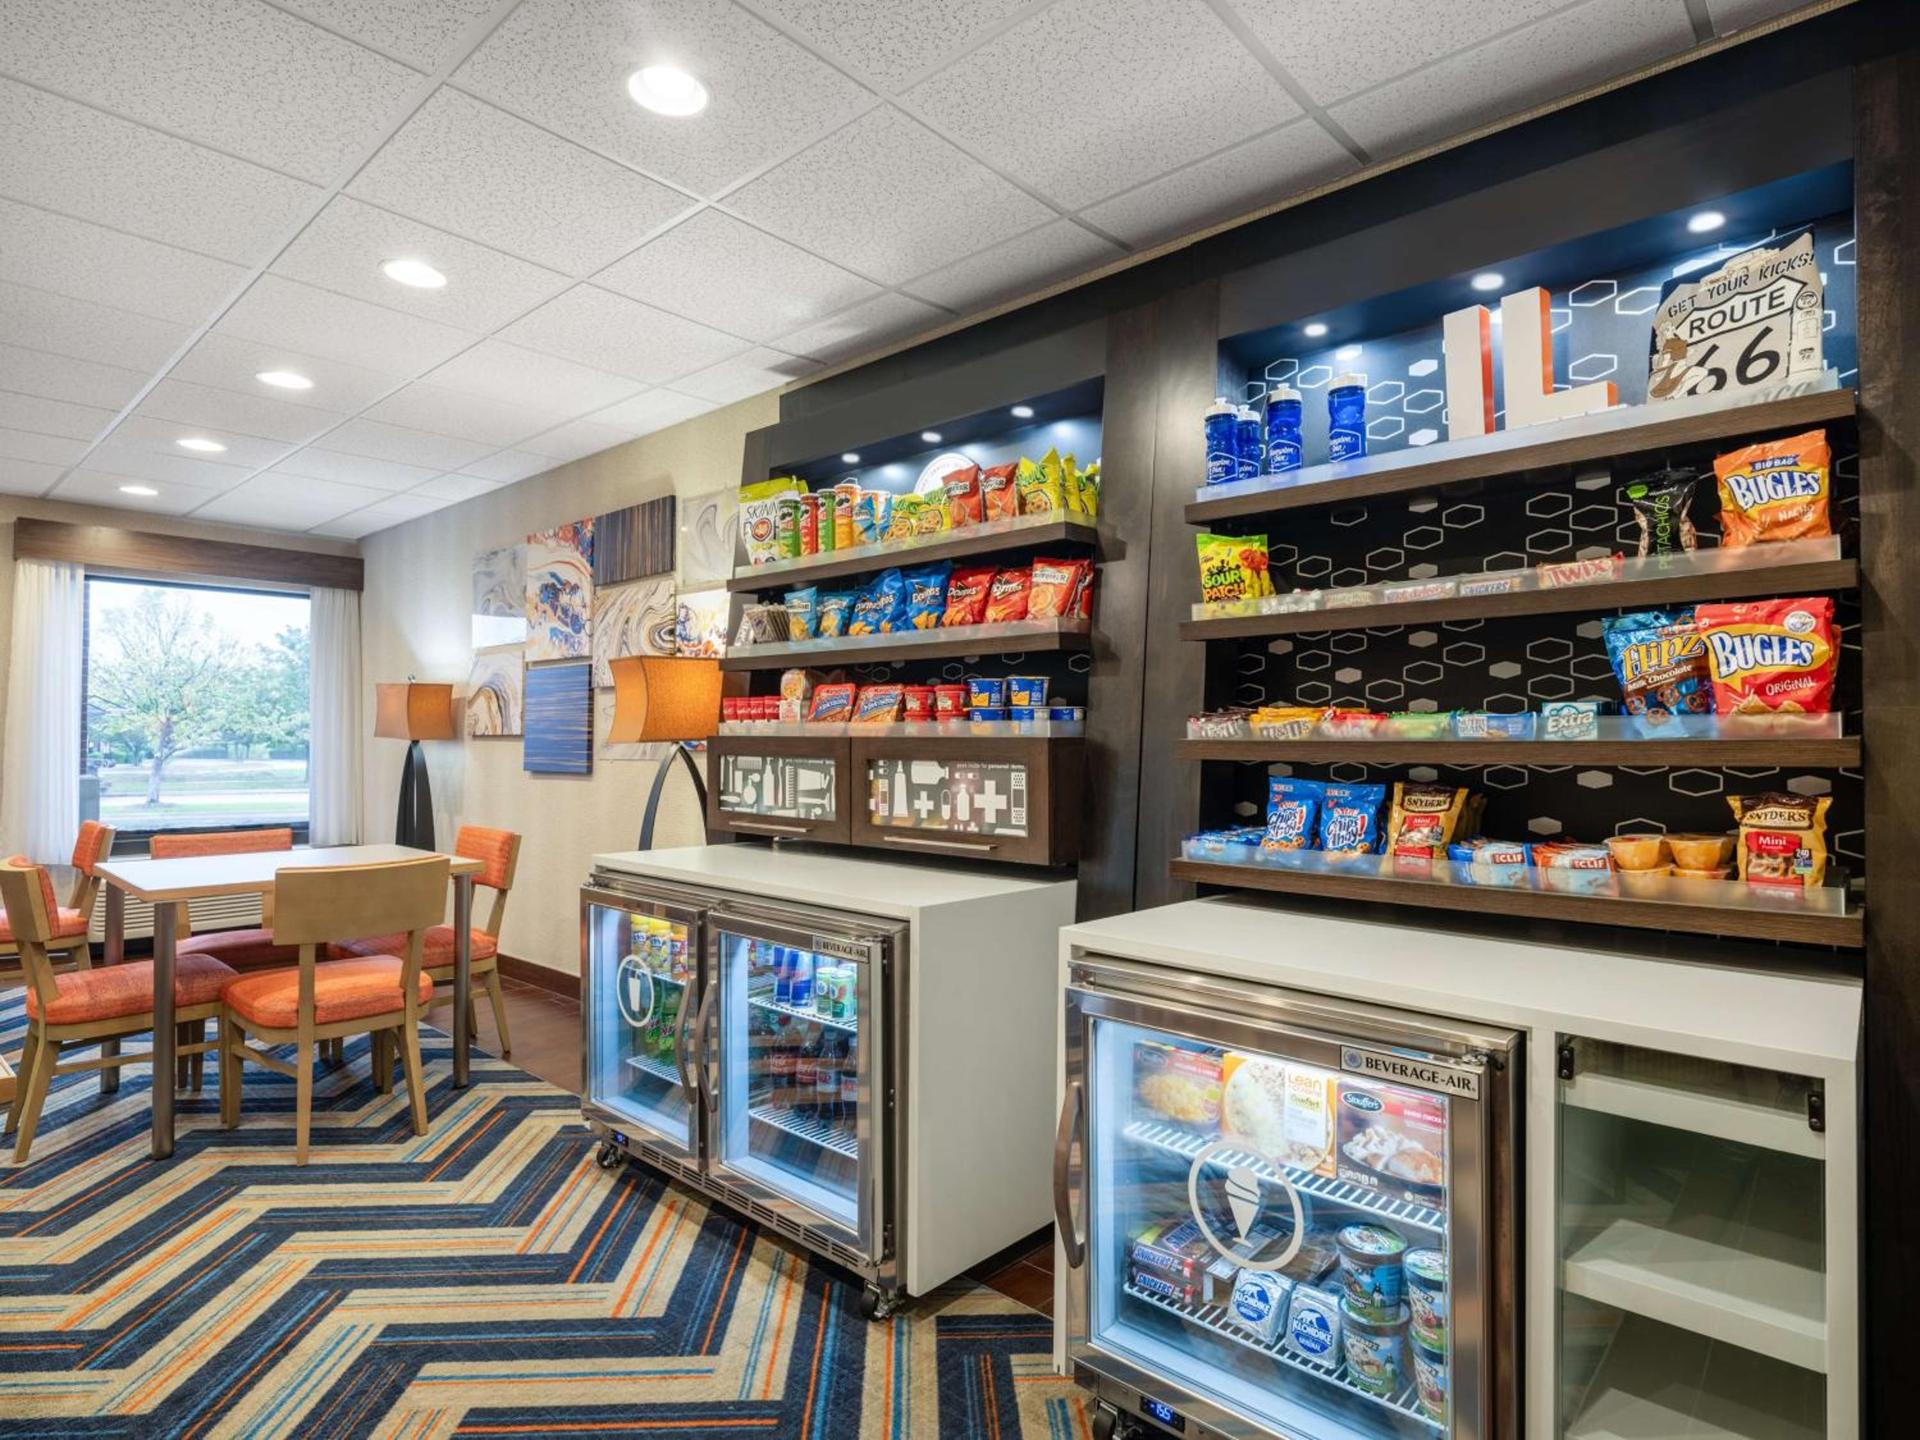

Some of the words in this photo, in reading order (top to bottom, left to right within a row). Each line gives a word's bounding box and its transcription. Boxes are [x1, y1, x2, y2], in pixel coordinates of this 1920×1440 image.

[1668, 294, 1697, 318] GET
[1707, 274, 1750, 300] YOUR
[1759, 252, 1814, 281] KICKS!
[1689, 286, 1786, 338] ROUTE
[1443, 286, 1620, 441] IL
[1686, 326, 1780, 396] 66
[1724, 471, 1820, 512] BUGLES
[1203, 572, 1241, 587] SOUR
[1203, 584, 1246, 598] PATCH
[1709, 631, 1815, 679] BUGLES
[1648, 663, 1692, 683] Chocolate
[1548, 711, 1594, 733] Extra
[1749, 810, 1807, 823] SNYDER'S
[1758, 835, 1787, 847] Mini
[1138, 1274, 1173, 1295] SNICKERS
[1233, 1288, 1272, 1316] KLONDIKE
[1292, 1317, 1334, 1347] KLONDIKE
